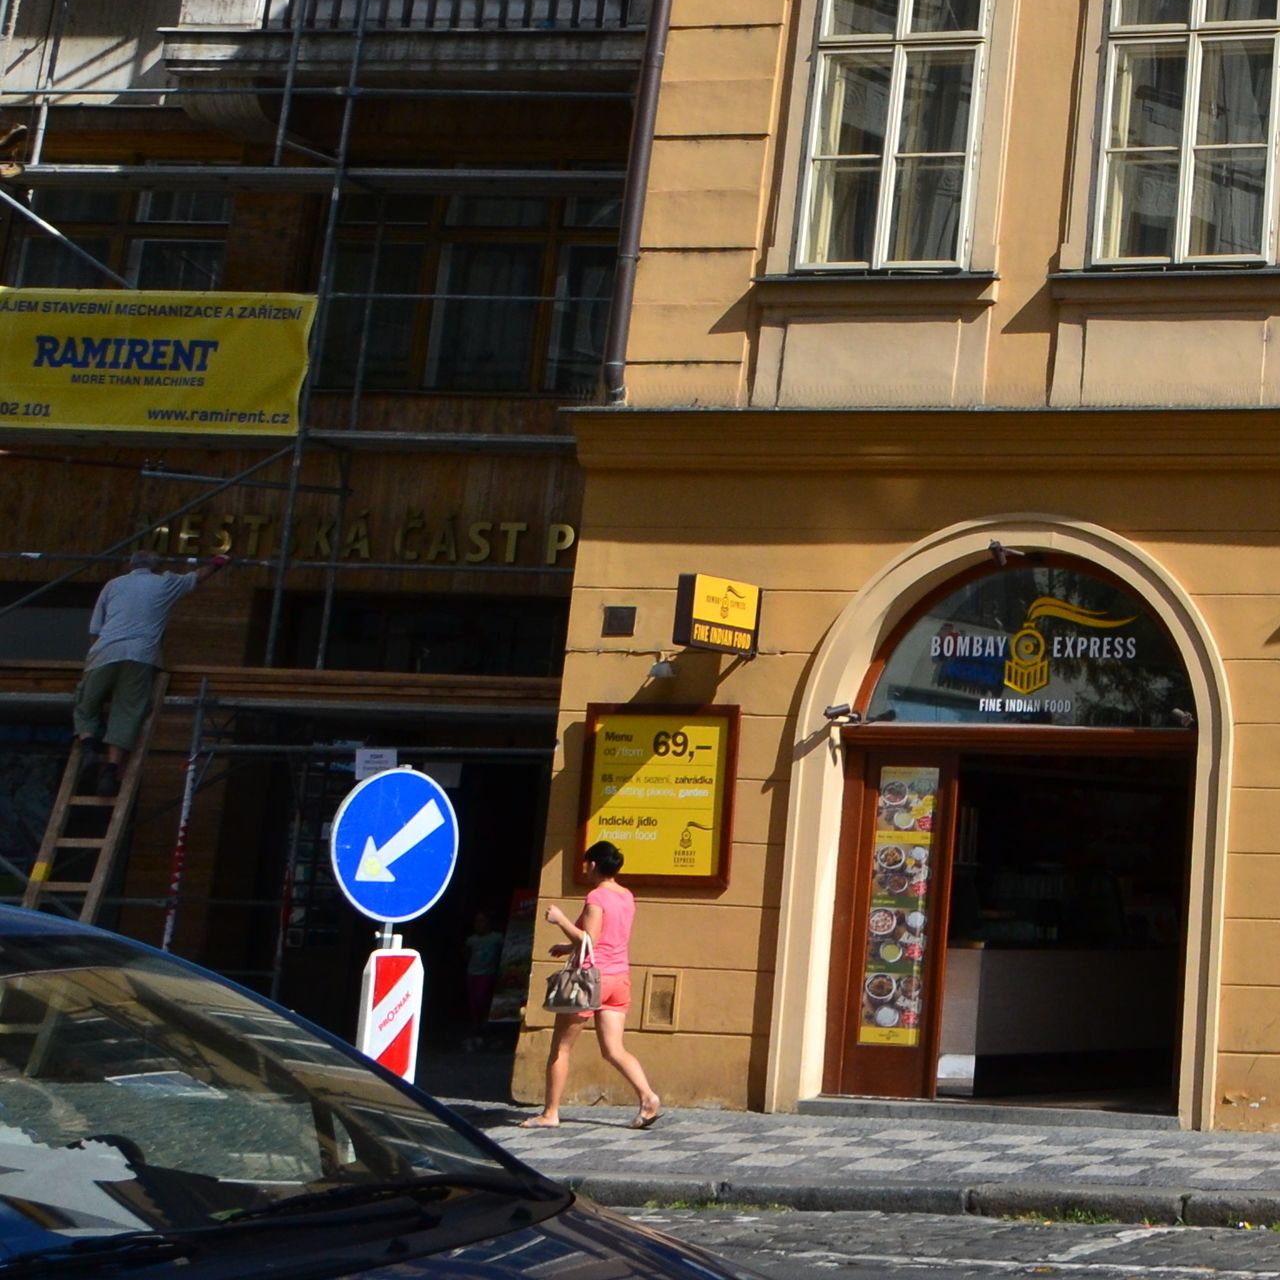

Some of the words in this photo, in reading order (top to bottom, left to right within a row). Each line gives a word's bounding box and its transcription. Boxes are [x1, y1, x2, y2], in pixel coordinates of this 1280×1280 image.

[41, 300, 112, 316] STAVEBNÍ
[115, 303, 223, 319] MECHANIZACE
[226, 307, 234, 318] A
[237, 305, 302, 320] ZAŘÍZENÍ
[33, 335, 219, 372] RAMIRENT
[71, 374, 107, 385] MORE
[109, 375, 140, 386] THAN
[143, 376, 205, 387] MACHINES
[22, 403, 51, 417] 101
[147, 408, 290, 425] www.ramirent.cz
[394, 513, 527, 564] ČÁST
[694, 624, 710, 642] FINE
[710, 627, 733, 646] INDIAN
[734, 632, 751, 650] FOOD
[929, 635, 1008, 658] BOMBAY
[1052, 636, 1138, 660] EXPRESS
[978, 698, 1003, 713] FINE
[1004, 699, 1041, 713] INDIAN
[1044, 700, 1072, 713] FOOD
[604, 731, 633, 742] Menu
[674, 775, 713, 784] zahrádka
[598, 816, 634, 826] Indické
[636, 816, 658, 828] jídlo
[635, 830, 657, 840] food
[379, 992, 411, 1031] PROZNAK
